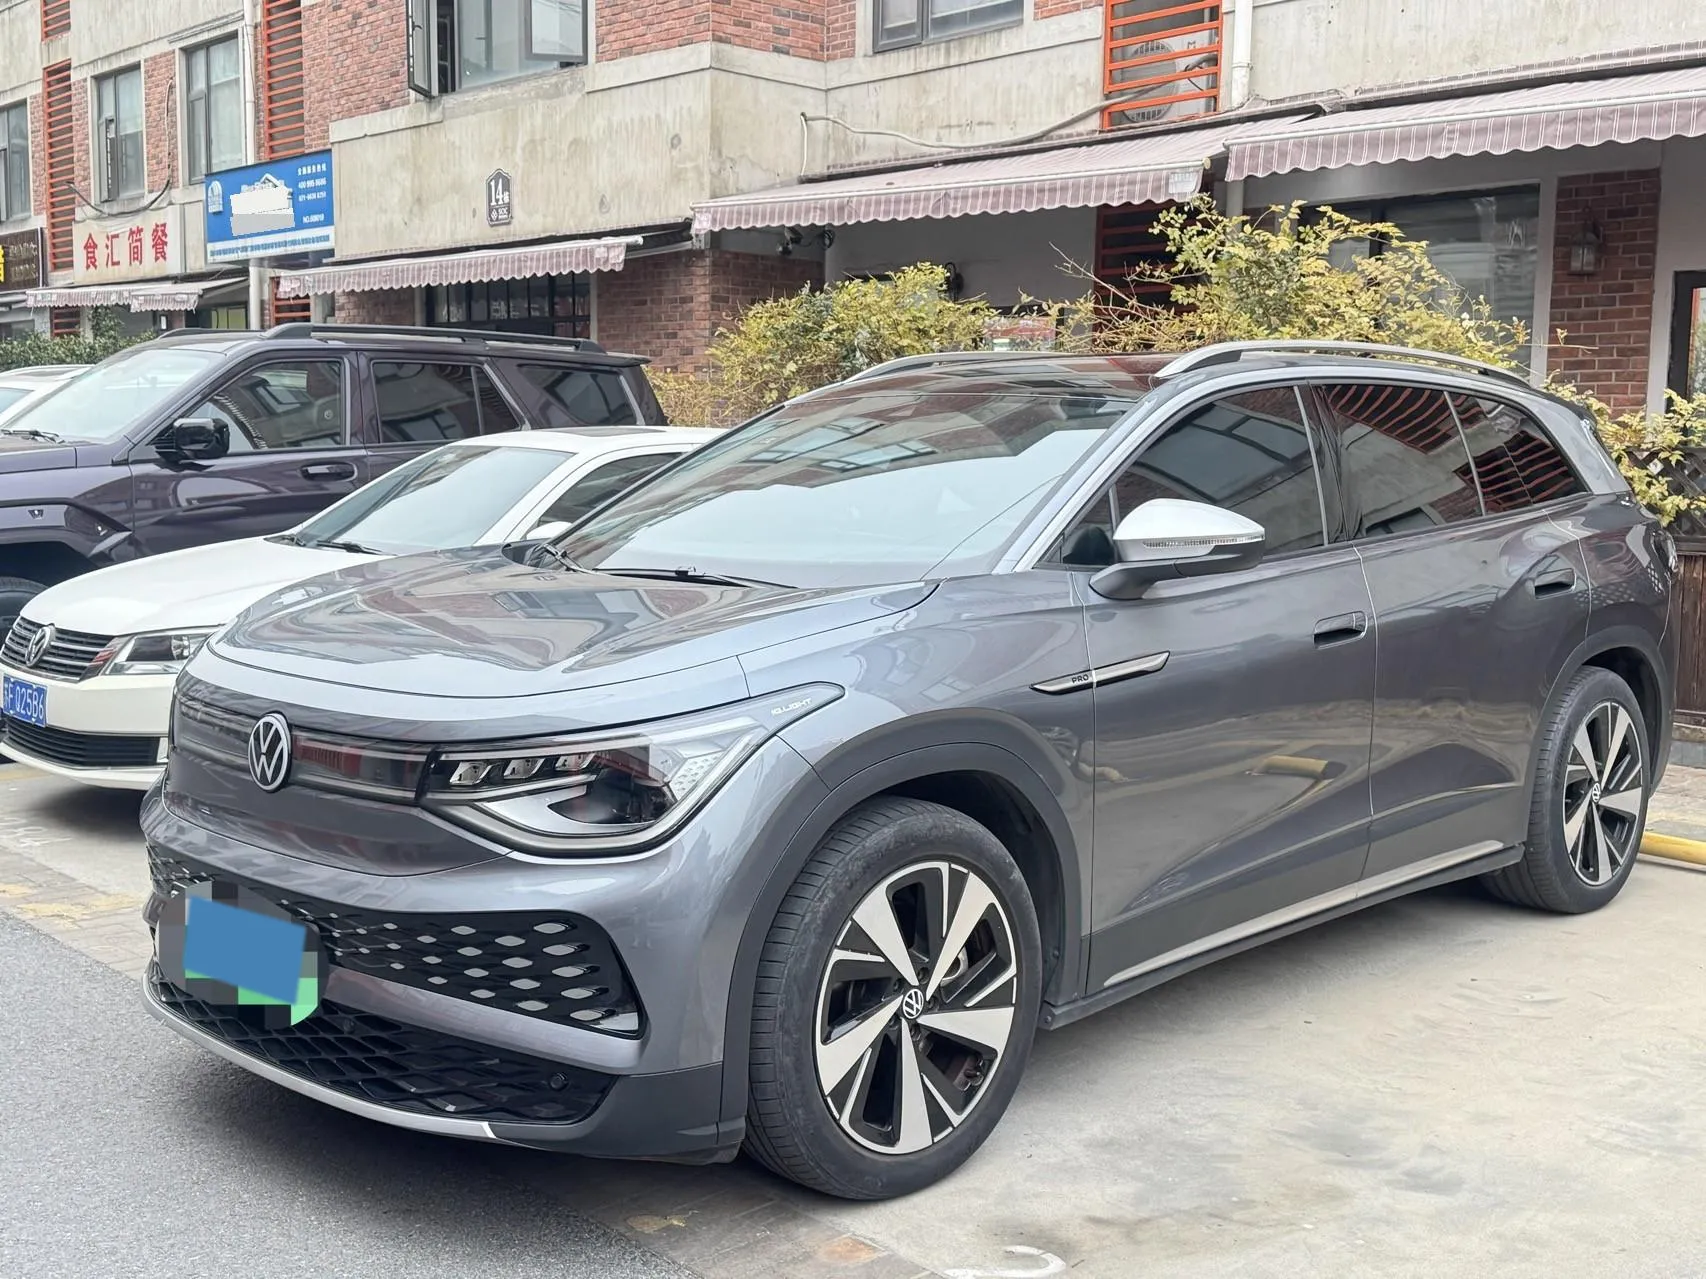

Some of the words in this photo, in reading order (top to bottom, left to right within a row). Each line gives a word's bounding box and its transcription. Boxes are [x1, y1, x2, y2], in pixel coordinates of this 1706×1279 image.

[83, 221, 168, 271] 食汇简餐
[1071, 673, 1089, 684] PRO
[15, 684, 44, 720] Q25B6
